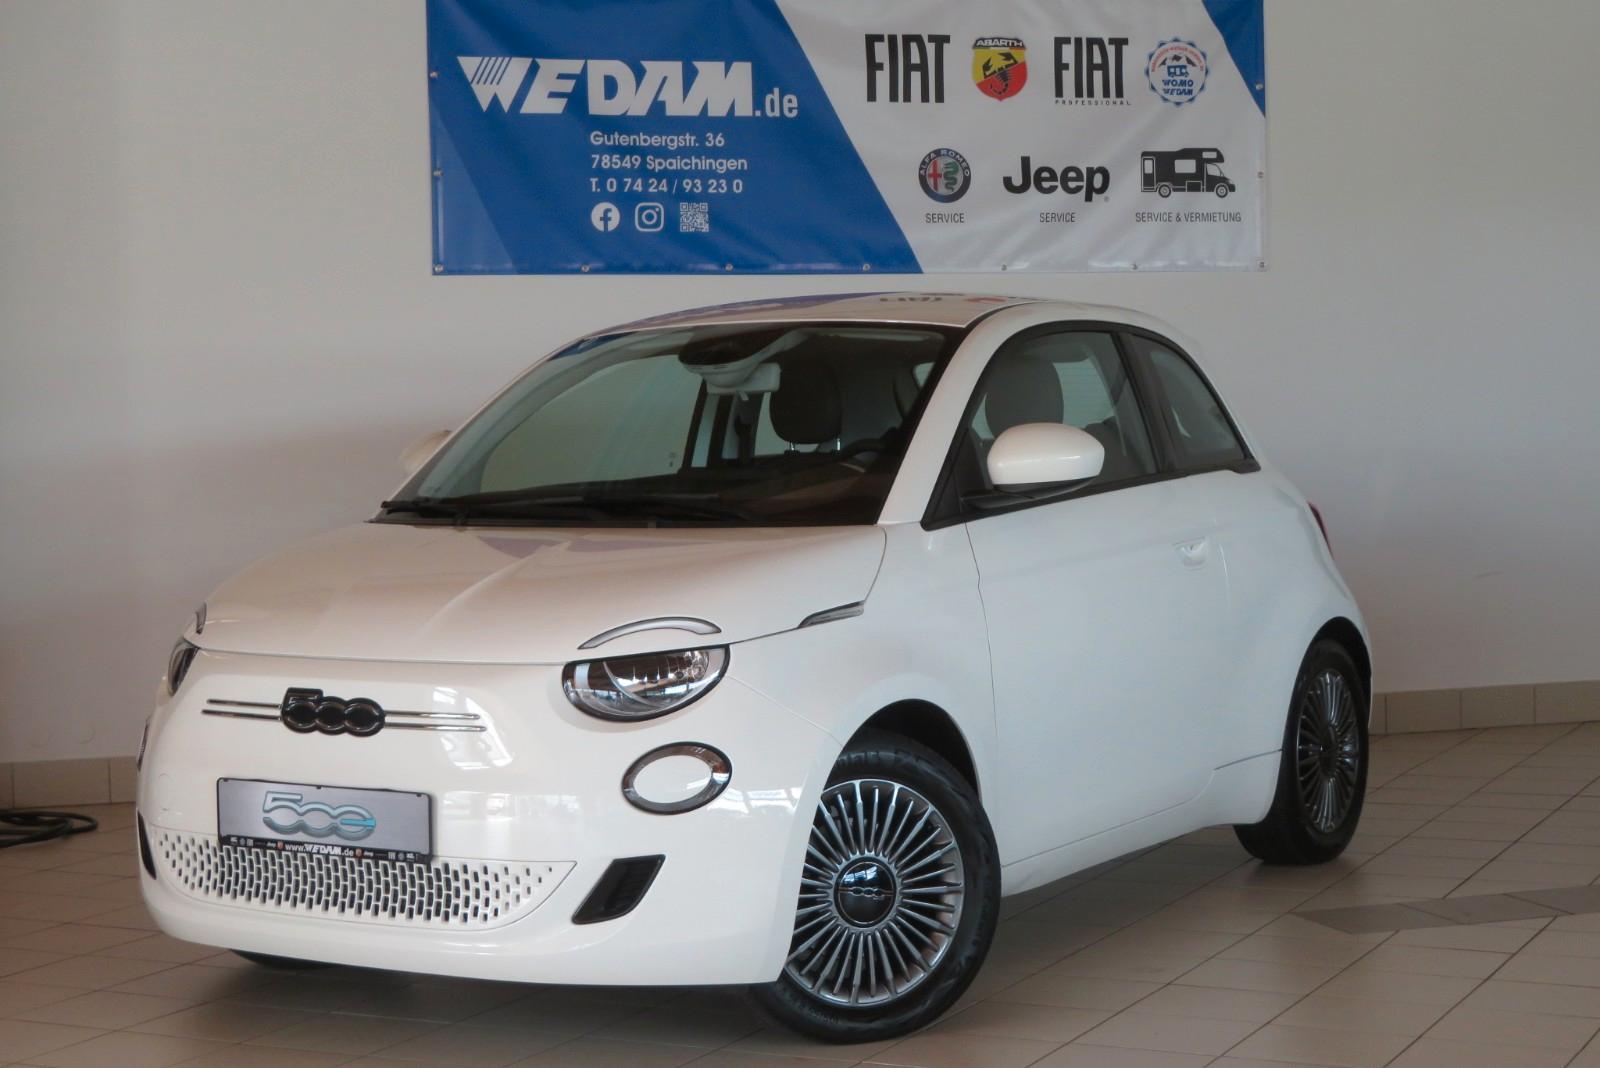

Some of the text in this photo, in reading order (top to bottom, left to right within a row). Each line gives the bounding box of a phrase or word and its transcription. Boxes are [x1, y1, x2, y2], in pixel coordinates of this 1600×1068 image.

[975, 38, 1024, 47] ABARTH
[864, 33, 951, 103] FIAT
[1053, 36, 1129, 99] FIAT
[1162, 79, 1194, 88] WOMO
[590, 131, 725, 150] Gutenbergstr. 36
[591, 154, 748, 173] 78549 Spaichingen
[920, 149, 970, 176] ALFA ROMEO
[589, 177, 601, 192] T.
[606, 178, 617, 192] 0
[623, 178, 643, 192] 74
[648, 178, 668, 193] 24
[682, 179, 702, 193] 93
[708, 179, 728, 193] 23
[732, 179, 743, 193] 0
[1003, 155, 1110, 202] Jeep
[925, 212, 965, 224] SERVICE
[1039, 212, 1076, 223] SERVICE
[1135, 211, 1242, 223] SERVICE & VERMIETUNG
[281, 687, 386, 737] 500
